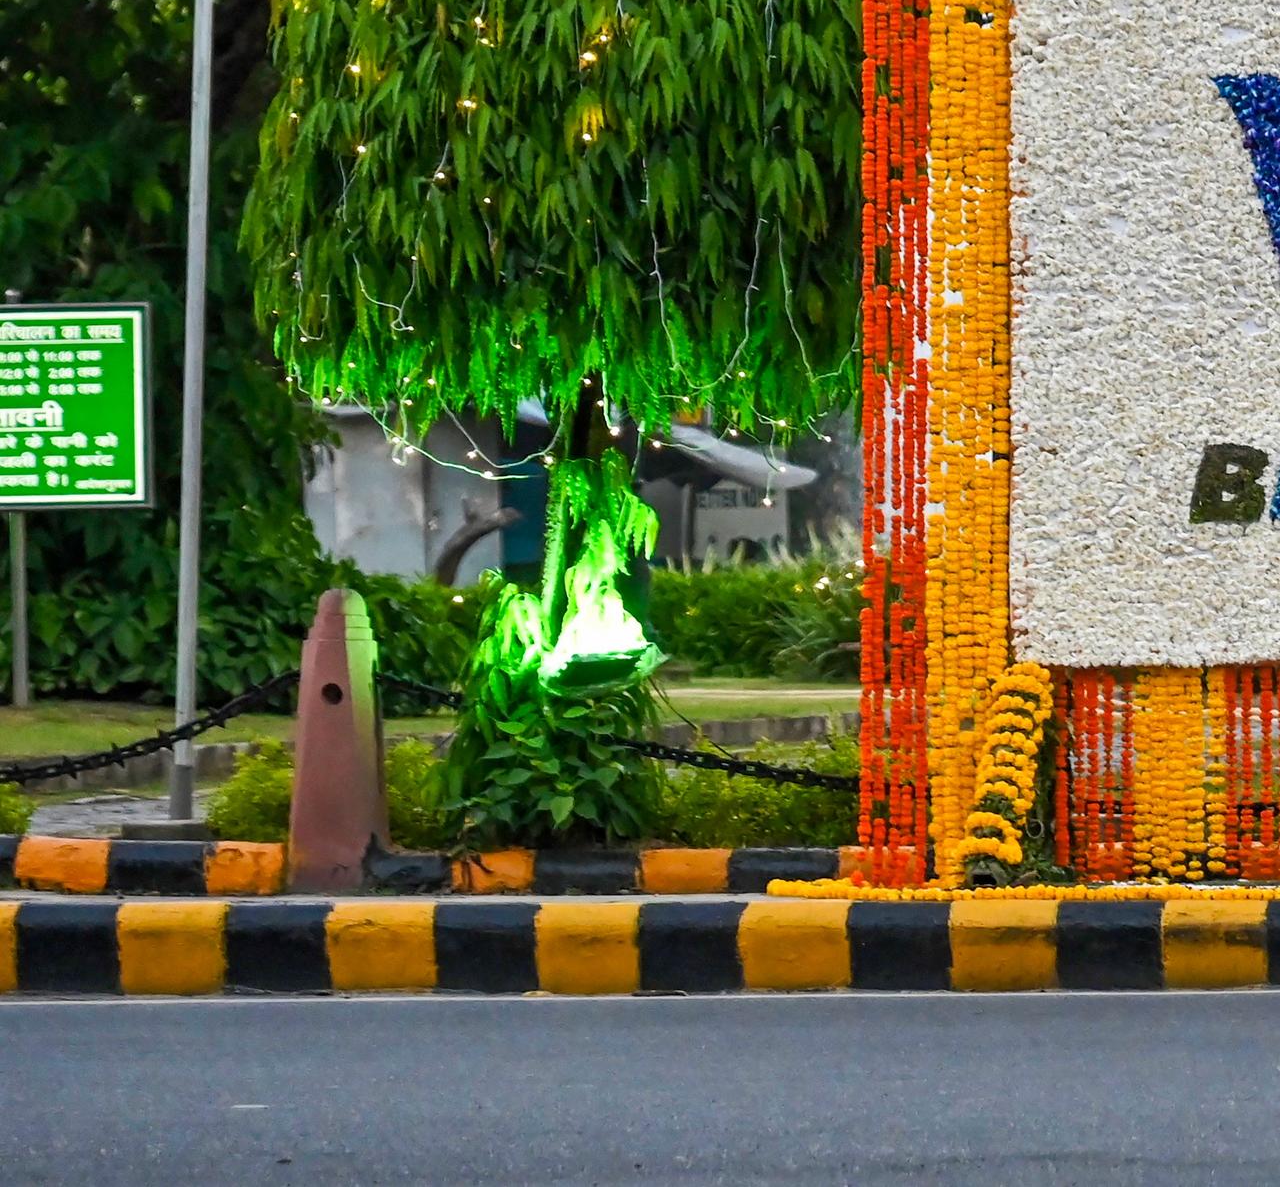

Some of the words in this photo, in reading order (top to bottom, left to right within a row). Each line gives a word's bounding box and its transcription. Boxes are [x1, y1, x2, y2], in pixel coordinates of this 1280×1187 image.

[60, 325, 81, 339] का
[86, 324, 122, 339] समय
[76, 350, 102, 362] तक
[76, 367, 102, 378] तक
[76, 383, 103, 395] तक
[42, 456, 68, 468] का
